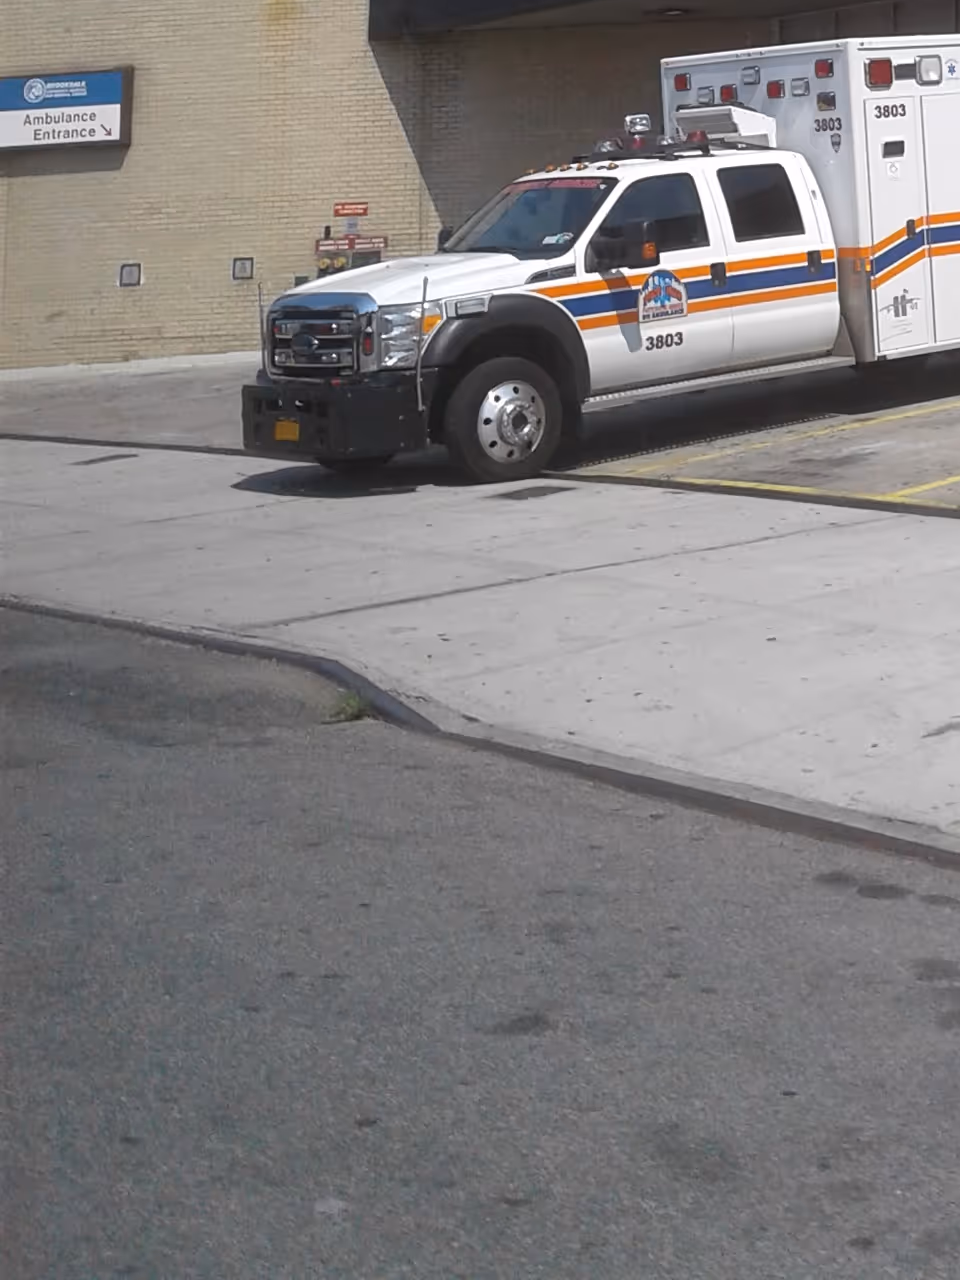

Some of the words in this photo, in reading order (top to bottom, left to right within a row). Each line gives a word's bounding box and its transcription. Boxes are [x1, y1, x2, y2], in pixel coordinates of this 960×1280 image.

[23, 111, 97, 126] Ambulance
[874, 104, 906, 119] 3803
[814, 117, 842, 132] 3803
[33, 128, 96, 141] Entrance
[645, 331, 683, 351] 3803
